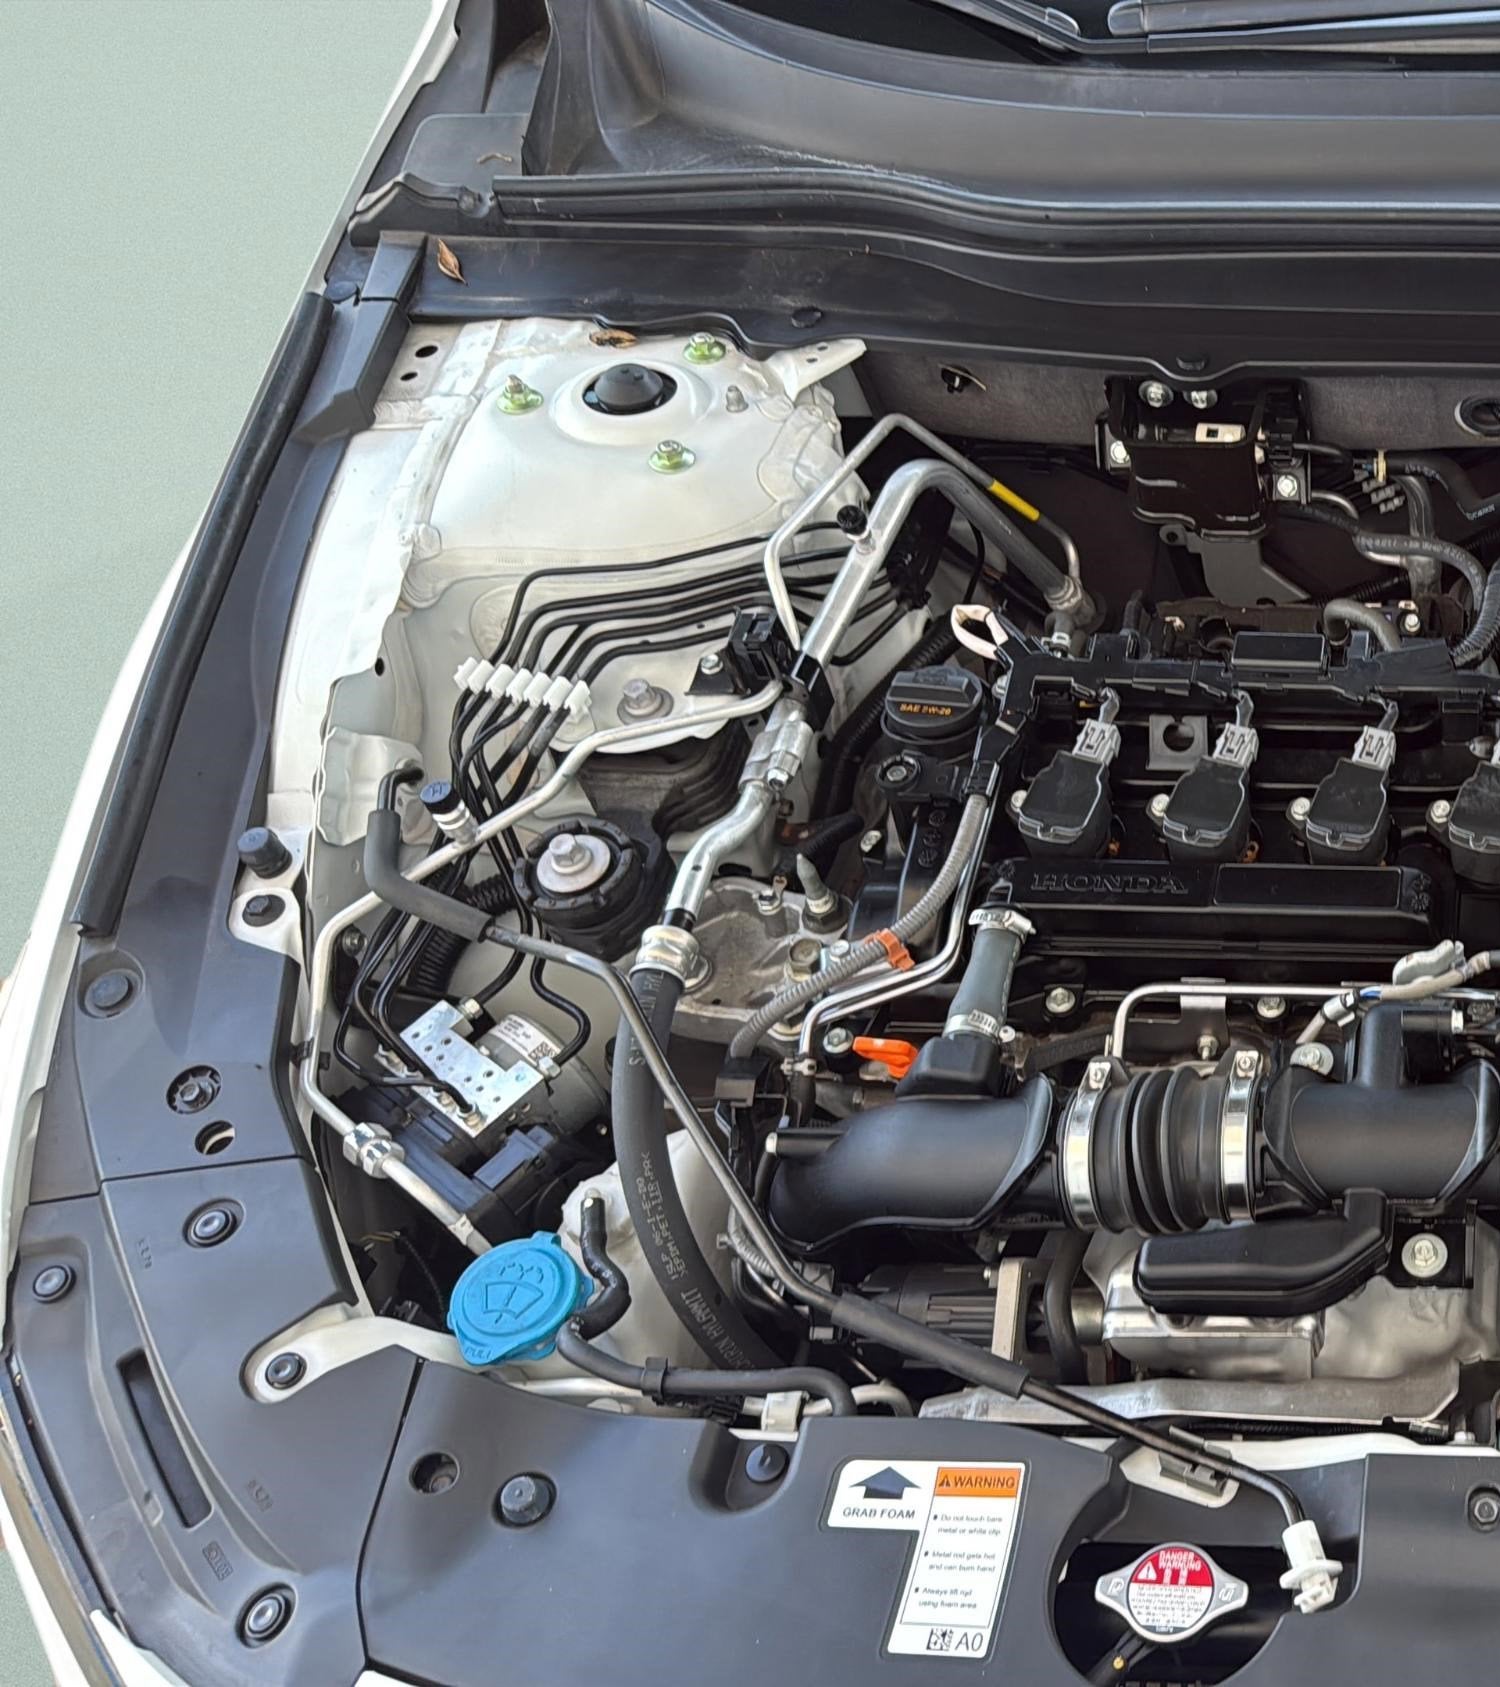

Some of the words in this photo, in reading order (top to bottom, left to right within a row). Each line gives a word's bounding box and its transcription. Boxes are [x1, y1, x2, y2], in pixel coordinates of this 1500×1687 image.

[900, 703, 921, 713] SAE
[1031, 872, 1188, 894] HONDA
[954, 1476, 1015, 1489] WARNING
[843, 1507, 877, 1518] GRAB
[880, 1508, 915, 1519] FOAM
[941, 1513, 952, 1521] Do
[966, 1514, 985, 1522] touch
[938, 1526, 958, 1534] metal
[968, 1527, 987, 1535] white
[983, 1552, 996, 1560] hot
[1160, 1550, 1195, 1561] DANGER
[958, 1564, 975, 1572] burn
[1158, 1559, 1202, 1571] WARNING
[922, 1587, 948, 1596] Always
[918, 1600, 939, 1608] using
[940, 1600, 959, 1608] foam
